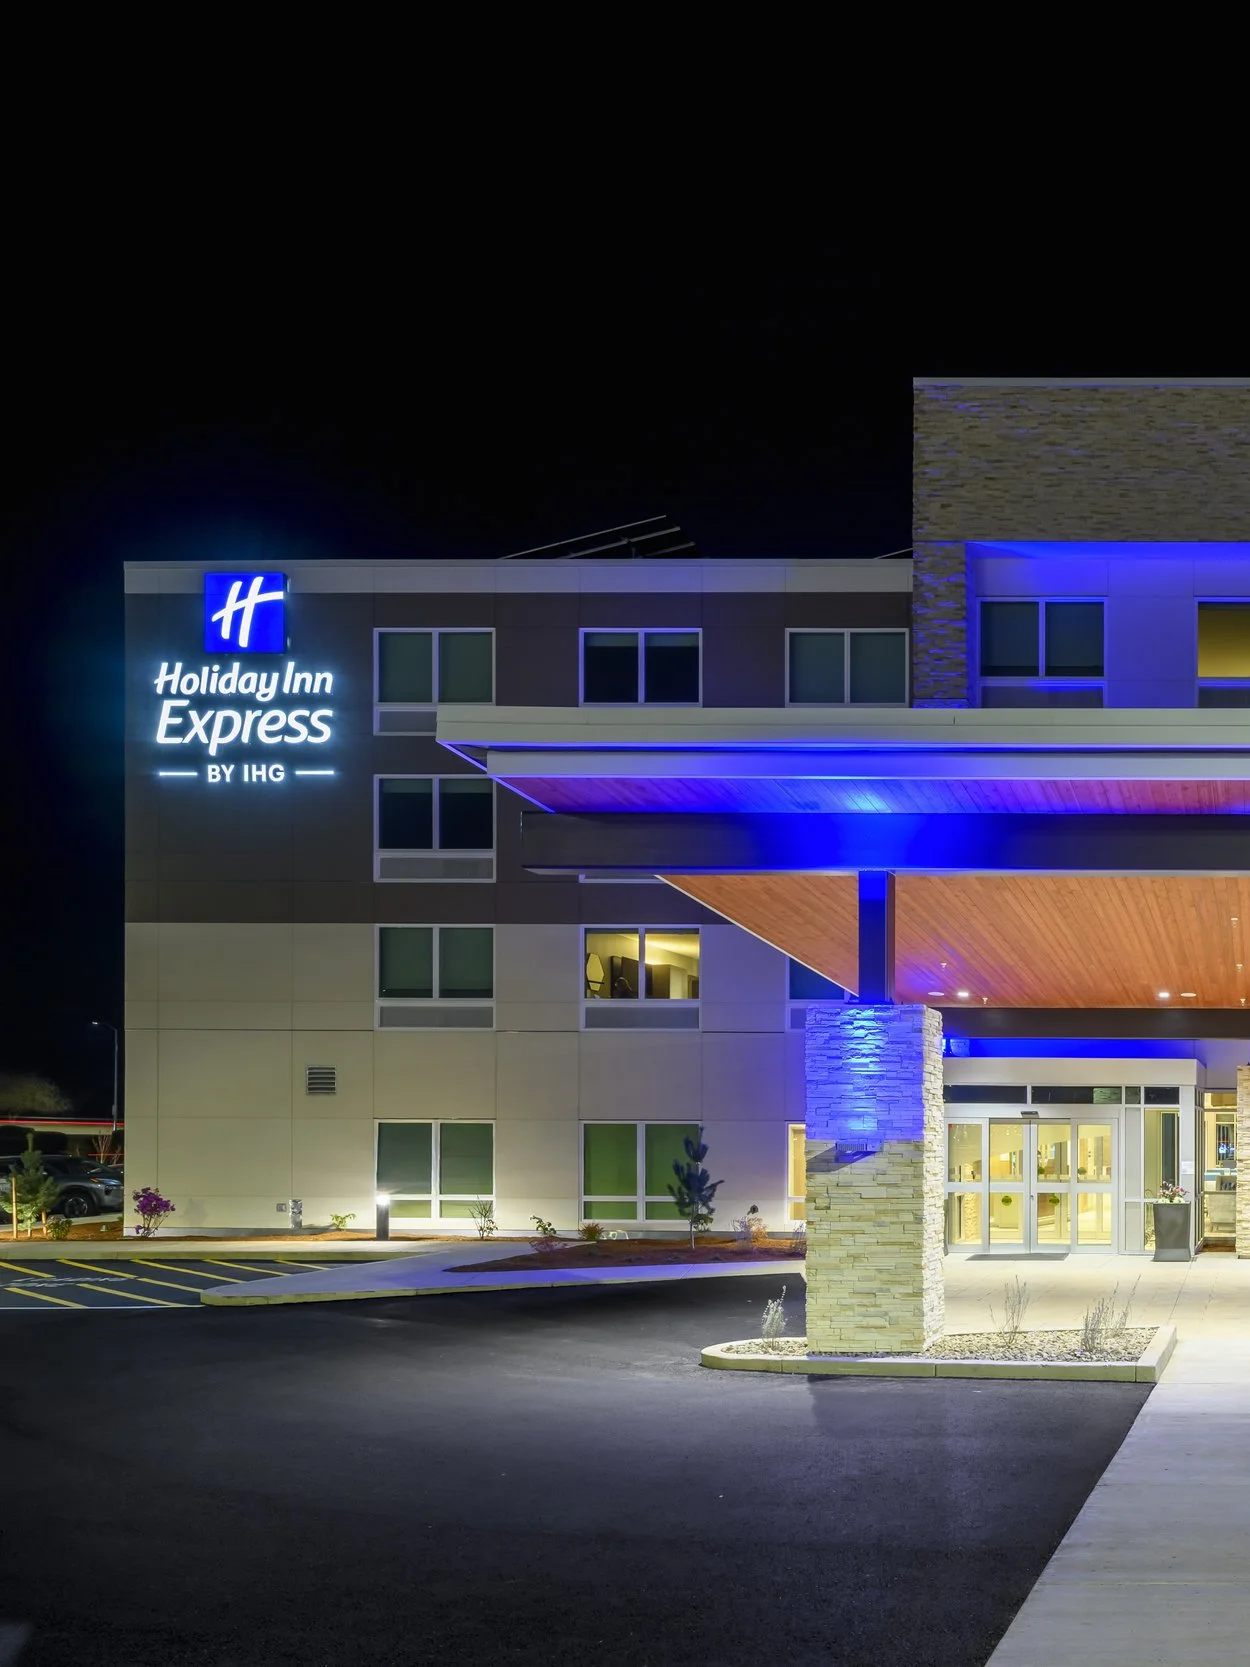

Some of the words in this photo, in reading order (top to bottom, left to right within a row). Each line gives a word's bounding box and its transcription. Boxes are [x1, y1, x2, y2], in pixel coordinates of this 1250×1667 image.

[154, 661, 278, 702] Holiday
[282, 661, 333, 694] Inn
[156, 699, 333, 756] Express
[207, 764, 235, 783] BY
[243, 763, 285, 782] IHG
